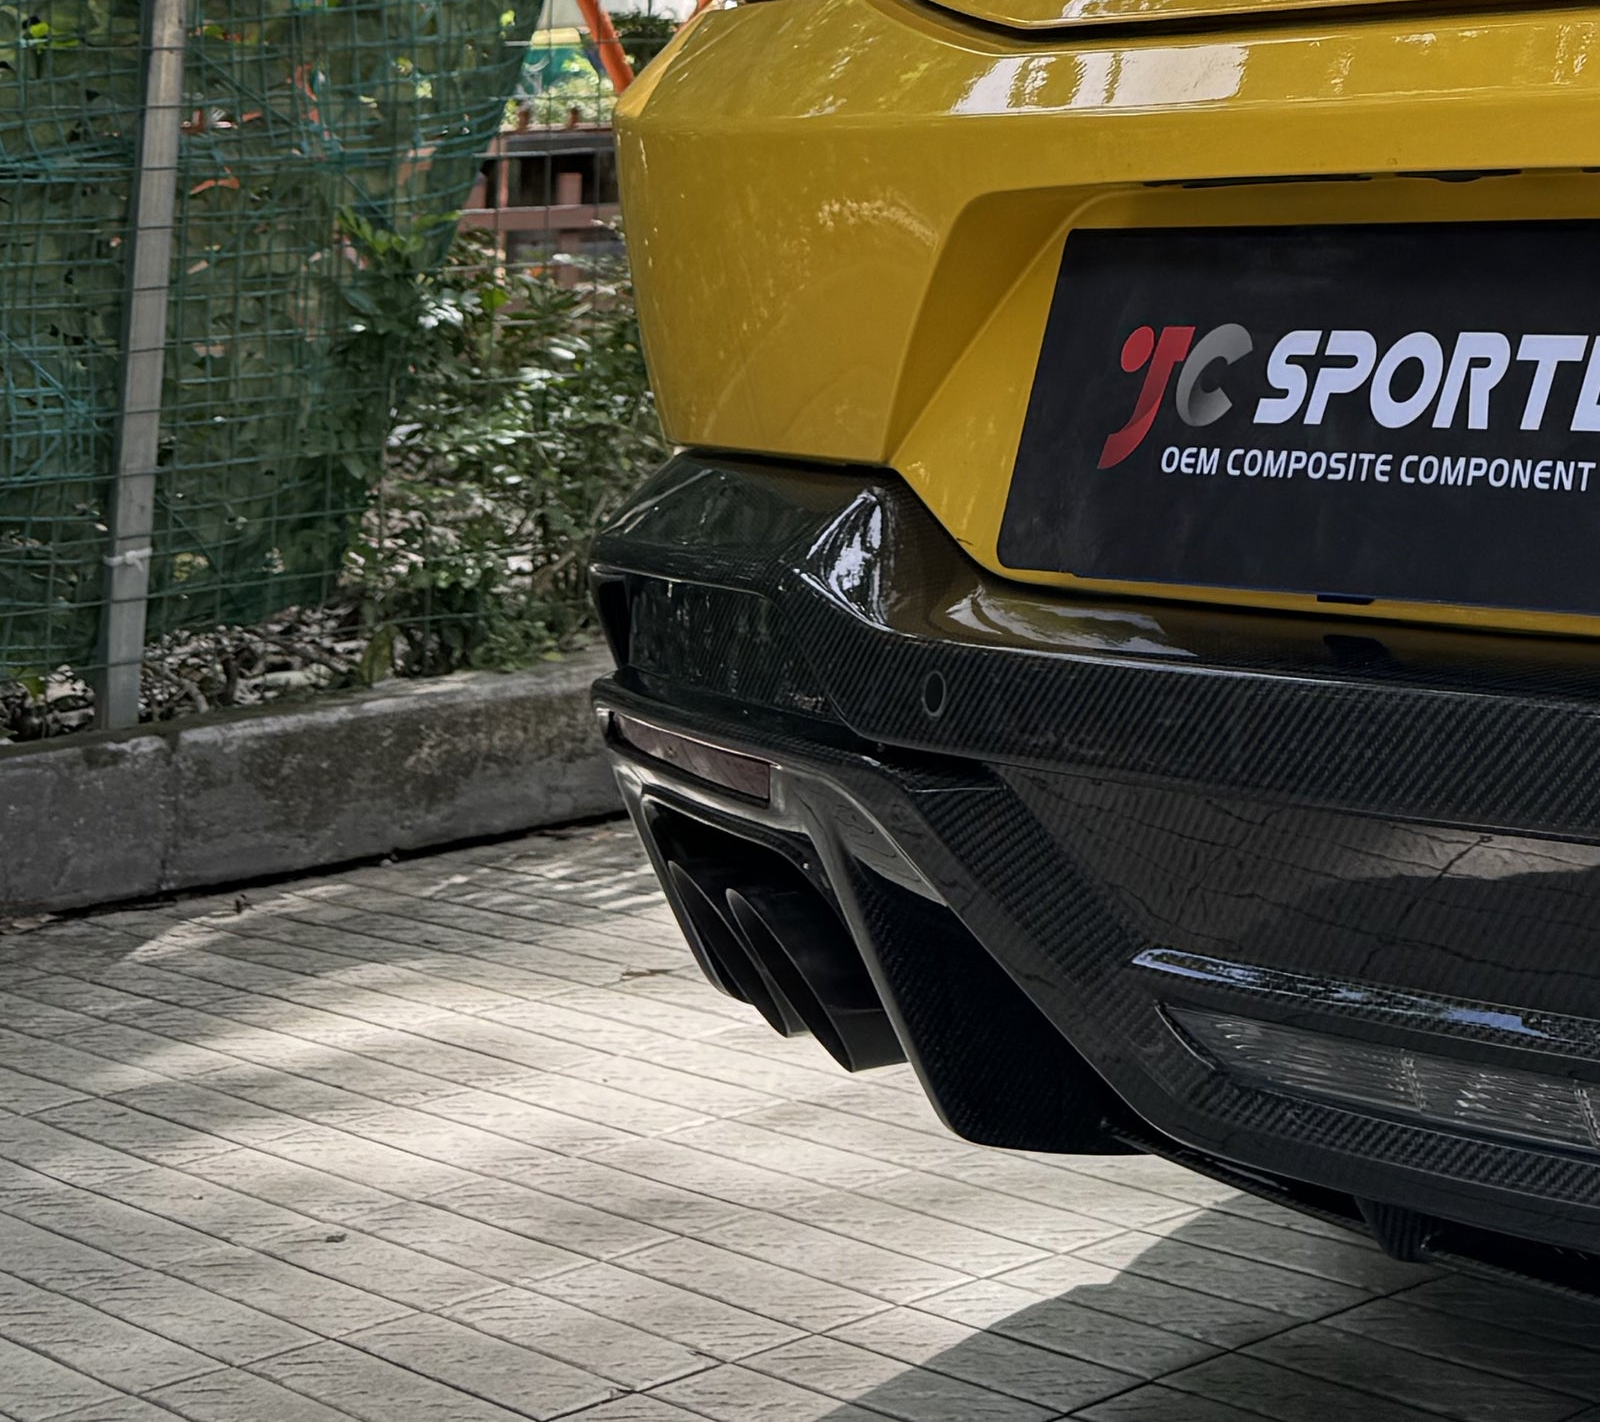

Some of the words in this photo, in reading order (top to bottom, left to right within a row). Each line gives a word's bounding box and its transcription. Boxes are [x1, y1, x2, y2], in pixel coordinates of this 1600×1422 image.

[1097, 323, 1254, 470] JC
[1160, 445, 1222, 476] OEM
[1225, 447, 1393, 483] COMPOSITE
[1399, 454, 1598, 493] COMPONENT
